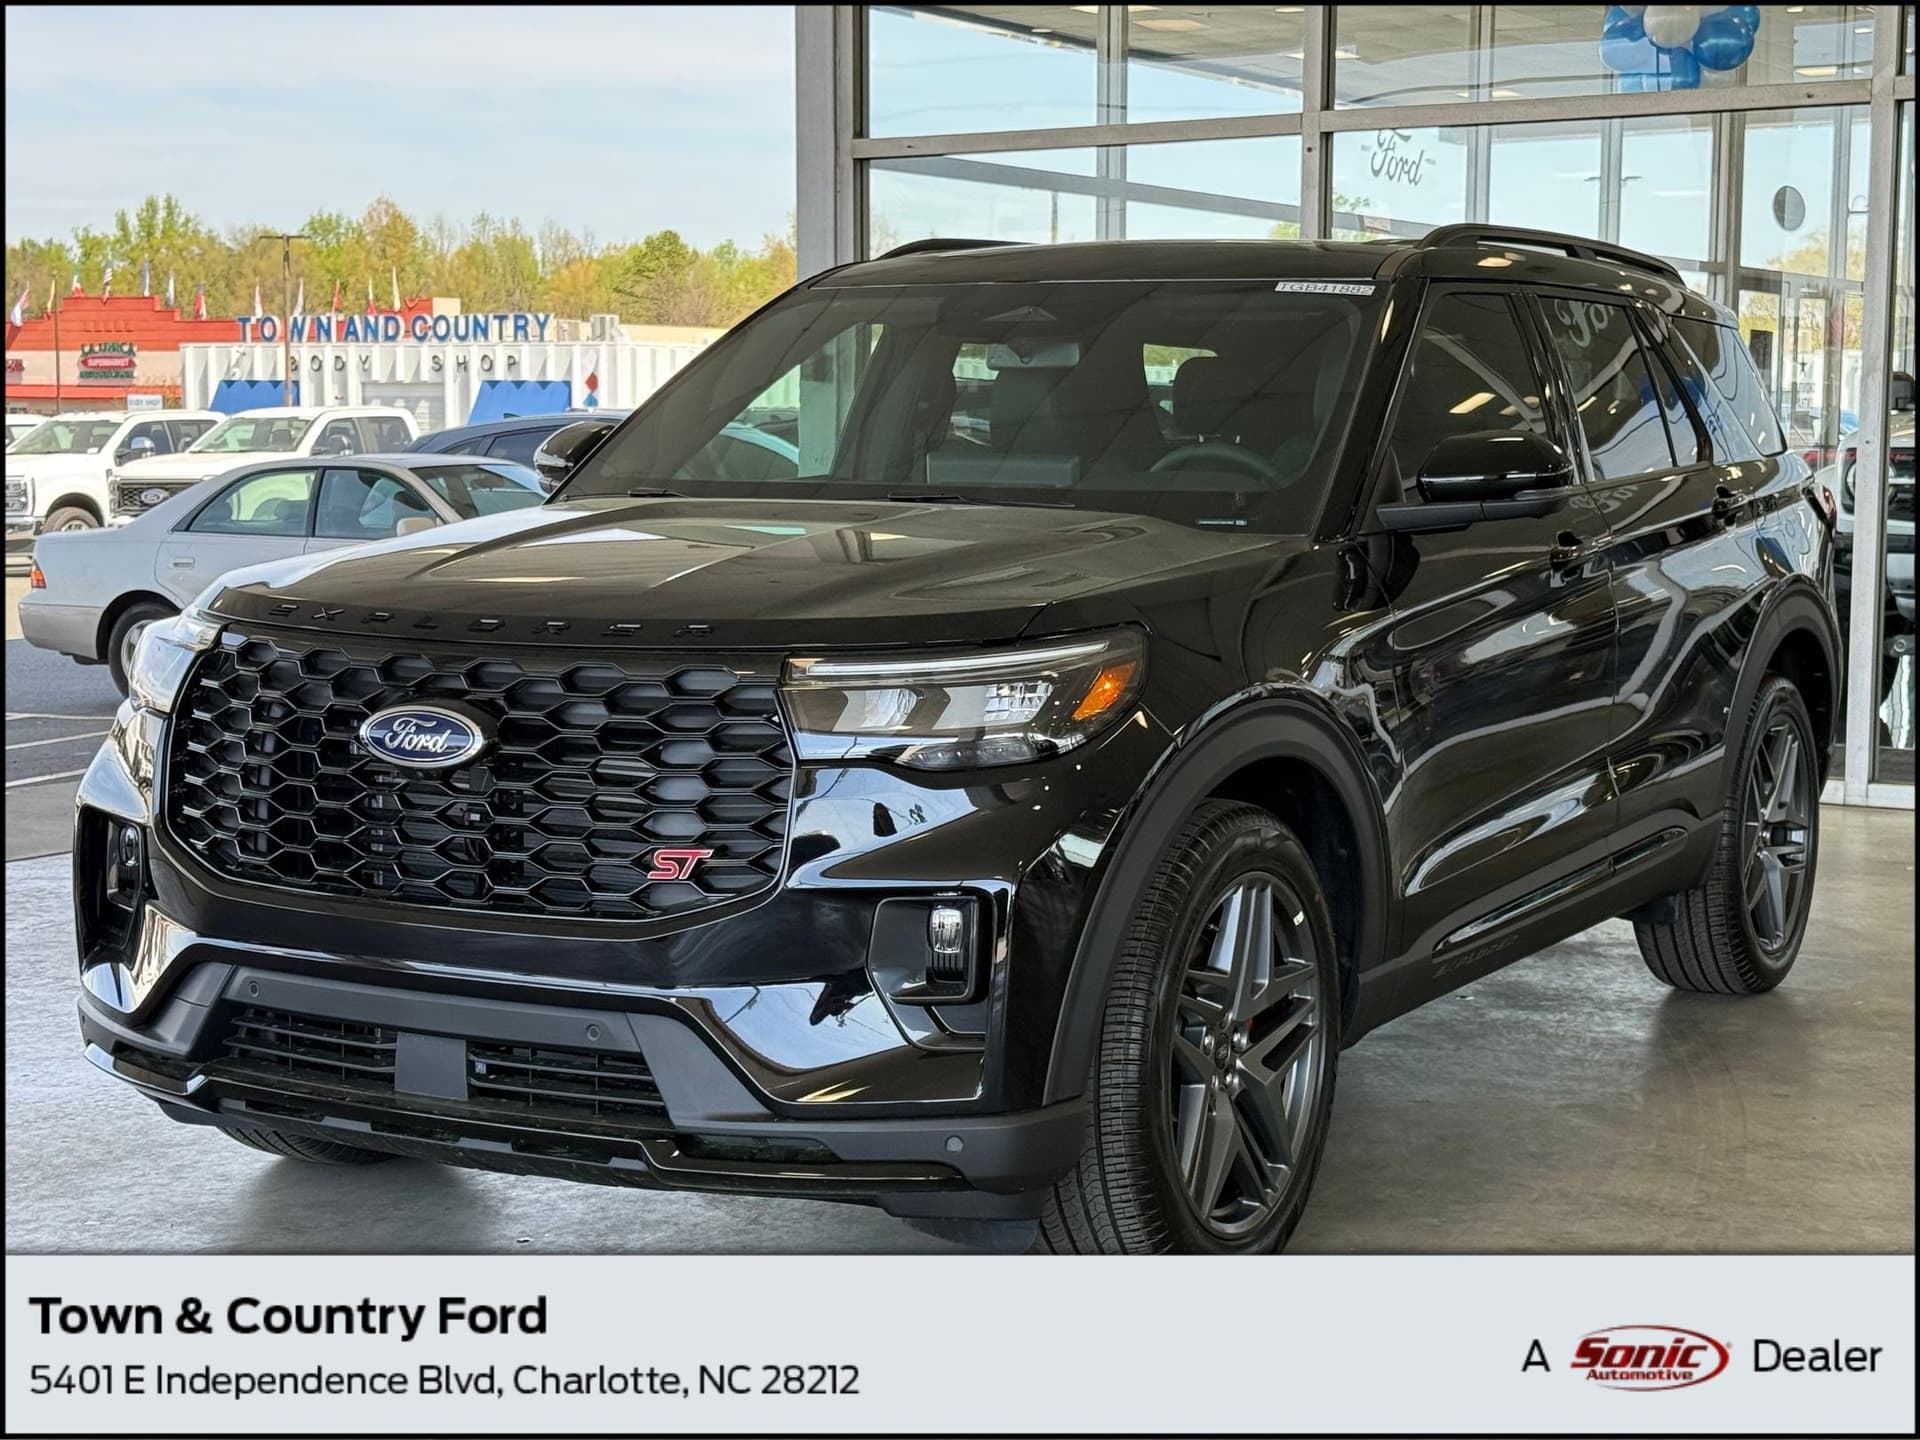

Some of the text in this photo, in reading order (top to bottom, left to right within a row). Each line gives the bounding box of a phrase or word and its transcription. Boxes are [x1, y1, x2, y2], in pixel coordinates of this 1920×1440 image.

[237, 314, 550, 343] TOWN AND COUNTRY
[432, 353, 519, 373] SHOP
[268, 602, 714, 638] EXPLORER
[384, 717, 451, 753] Ford
[647, 848, 715, 880] ST
